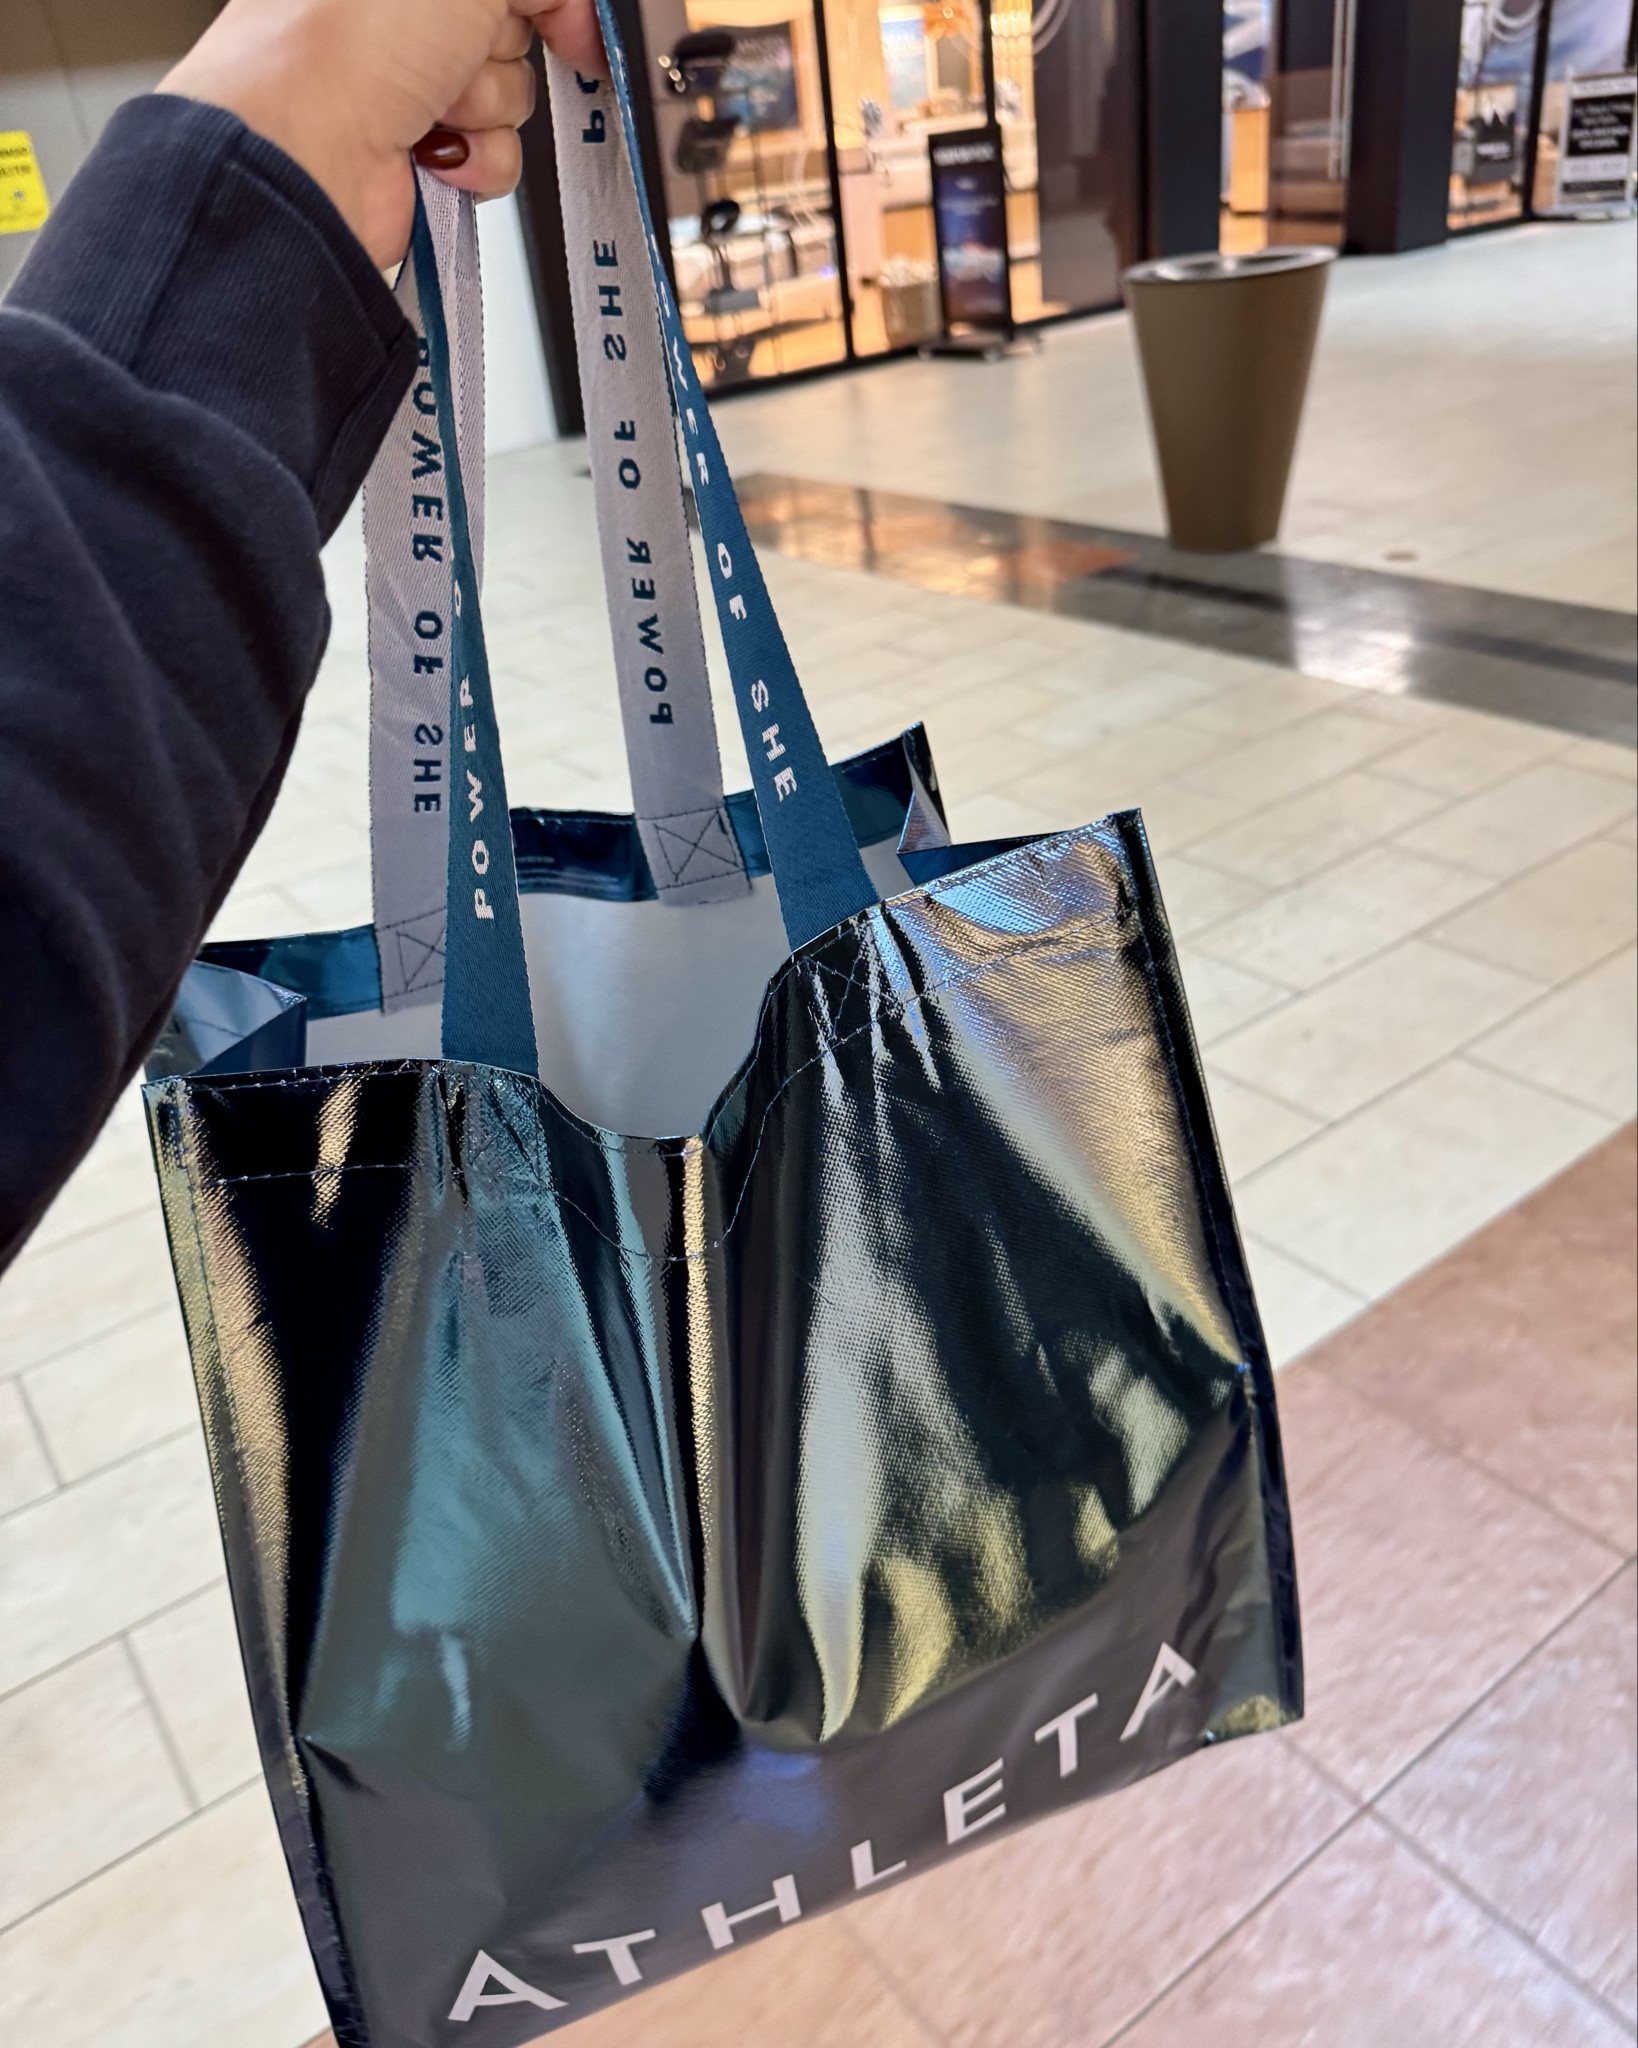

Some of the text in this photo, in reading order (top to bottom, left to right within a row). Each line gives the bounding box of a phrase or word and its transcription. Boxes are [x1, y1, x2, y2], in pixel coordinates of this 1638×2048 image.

[460, 675, 494, 920] POWER
[717, 542, 747, 621] OF
[751, 680, 797, 802] SHE
[448, 1642, 1196, 2022] ATHLETA
